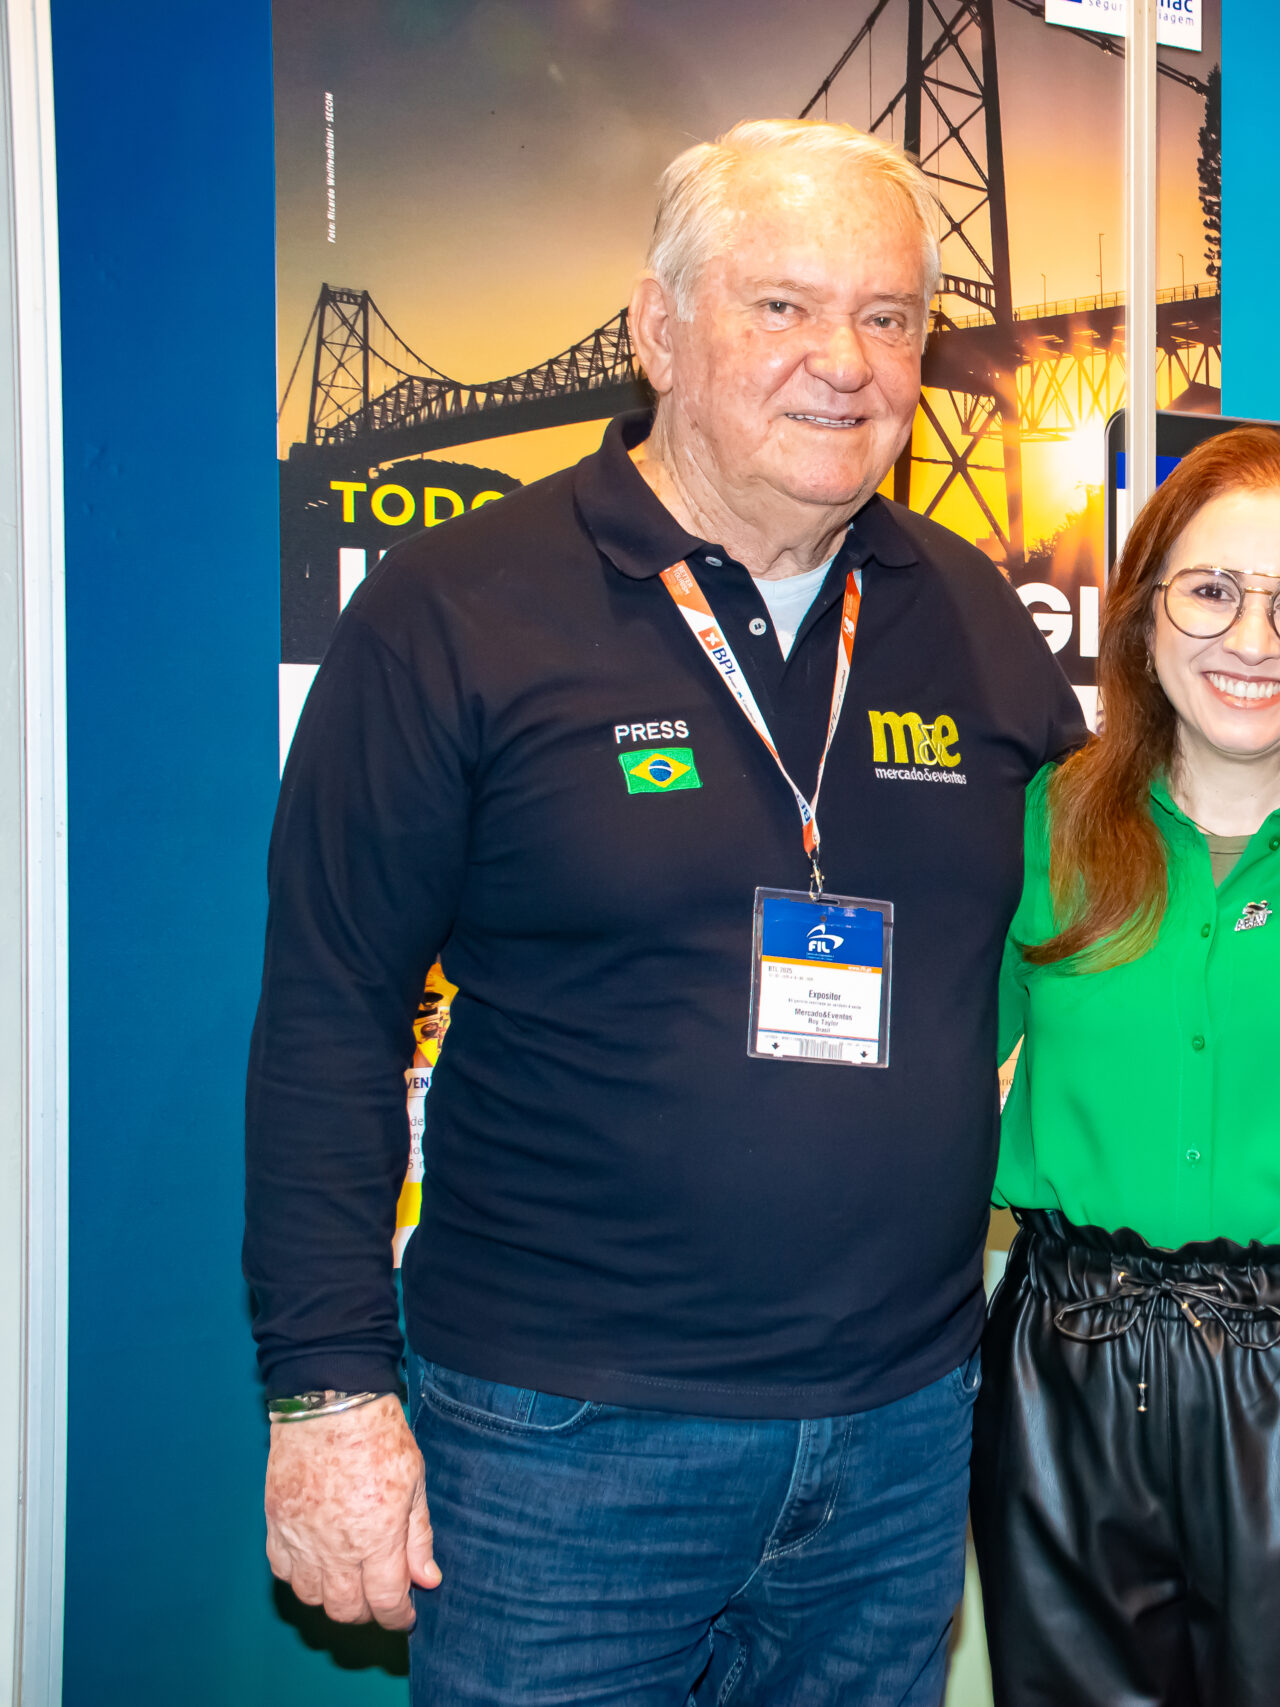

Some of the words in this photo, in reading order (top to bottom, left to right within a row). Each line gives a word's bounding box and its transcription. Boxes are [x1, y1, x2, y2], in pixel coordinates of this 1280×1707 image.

[325, 92, 334, 122] SECOM
[712, 648, 736, 675] BPI
[614, 720, 689, 743] PRESS
[868, 710, 962, 767] m&e
[875, 767, 967, 785] mercado&eventos
[808, 940, 831, 953] FIL
[808, 990, 841, 1001] Expositor
[795, 1008, 852, 1020] Mercado&Eventos
